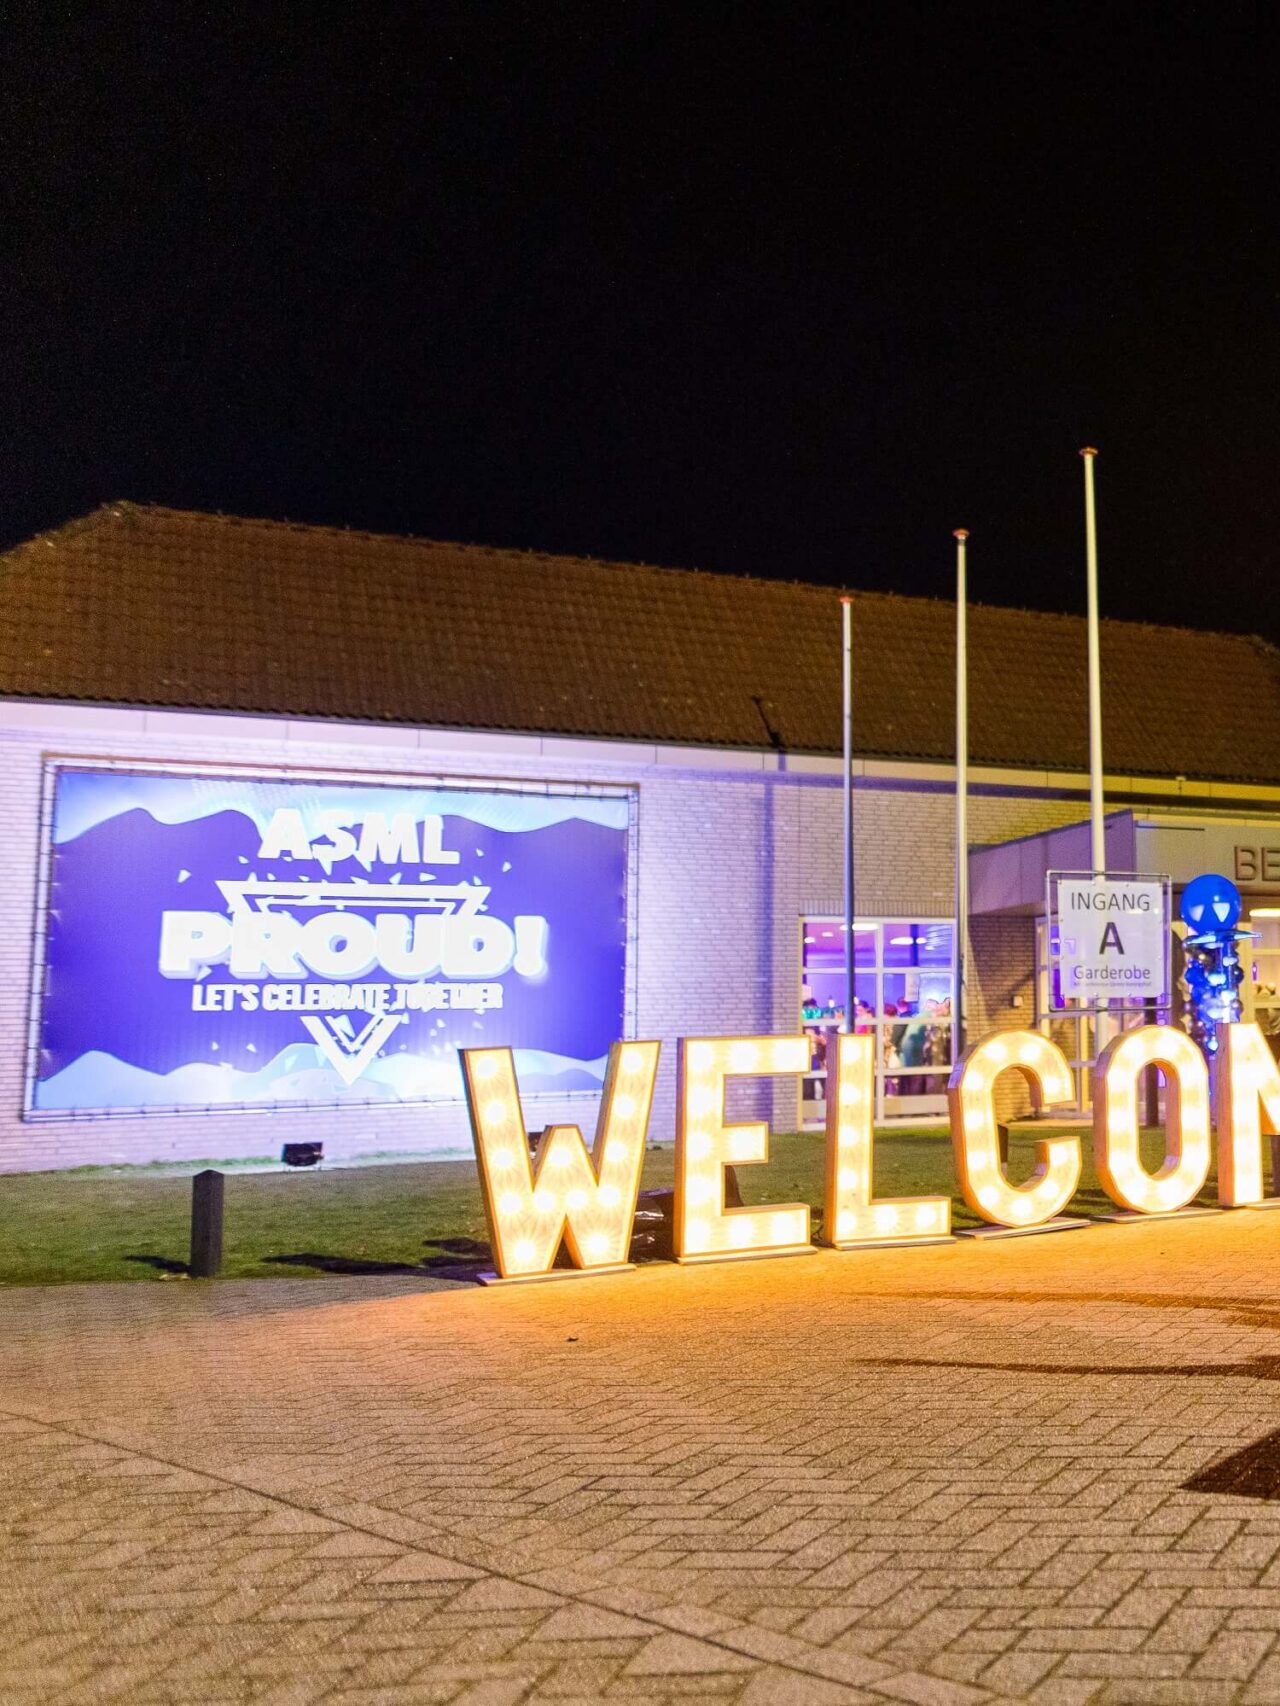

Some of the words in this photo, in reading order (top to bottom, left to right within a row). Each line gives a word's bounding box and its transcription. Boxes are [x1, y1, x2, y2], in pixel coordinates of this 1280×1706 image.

[257, 808, 461, 865] ASML
[1070, 891, 1151, 912] INGANG
[159, 910, 549, 981] PROUD!
[1098, 921, 1126, 956] A
[1073, 964, 1152, 981] Garderobe
[191, 983, 260, 1012] LET'S
[262, 983, 391, 1011] CELEBRATE
